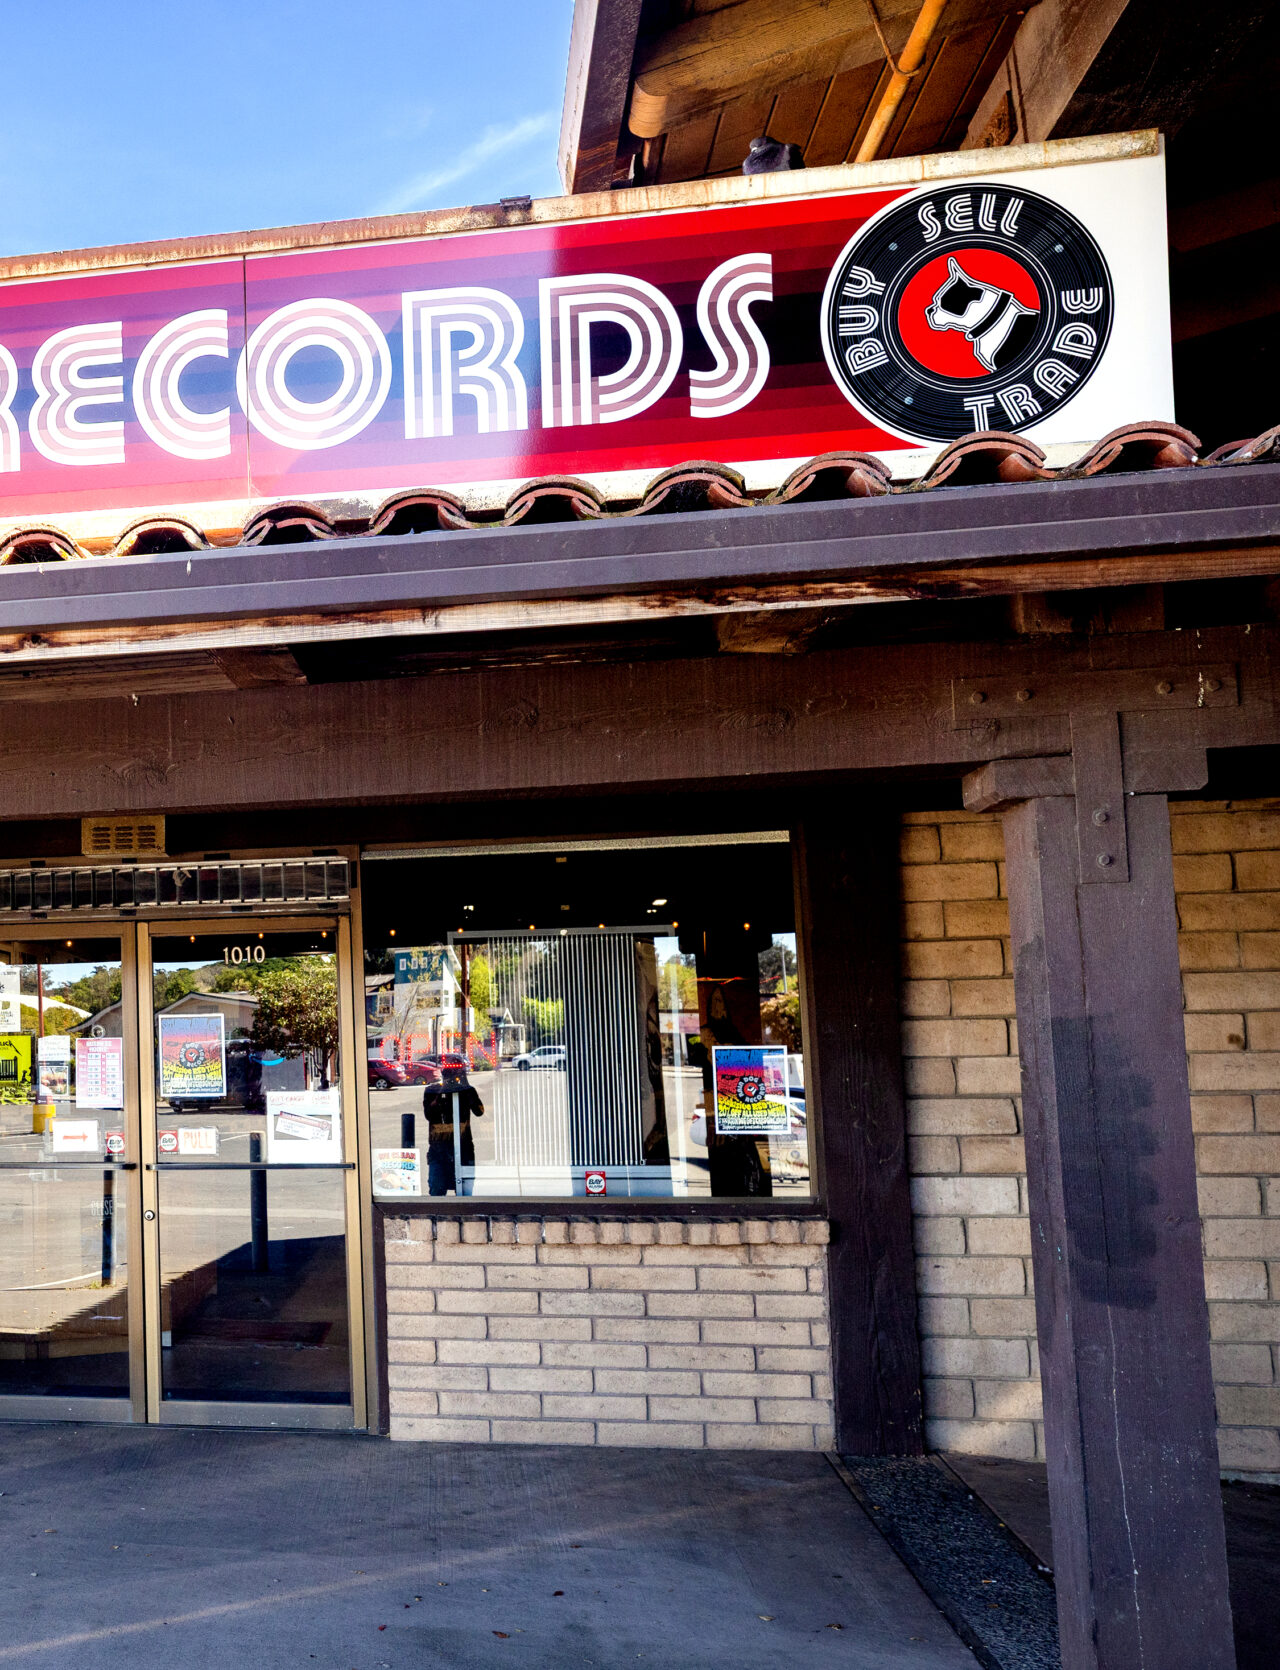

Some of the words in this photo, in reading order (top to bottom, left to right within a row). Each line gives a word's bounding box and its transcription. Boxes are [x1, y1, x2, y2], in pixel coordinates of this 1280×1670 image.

[918, 193, 1024, 242] SELL
[838, 265, 886, 376] BUY
[963, 286, 1104, 433] TRADE
[223, 945, 265, 965] 1010
[380, 1031, 497, 1069] OPEN
[183, 1131, 213, 1149] PULL
